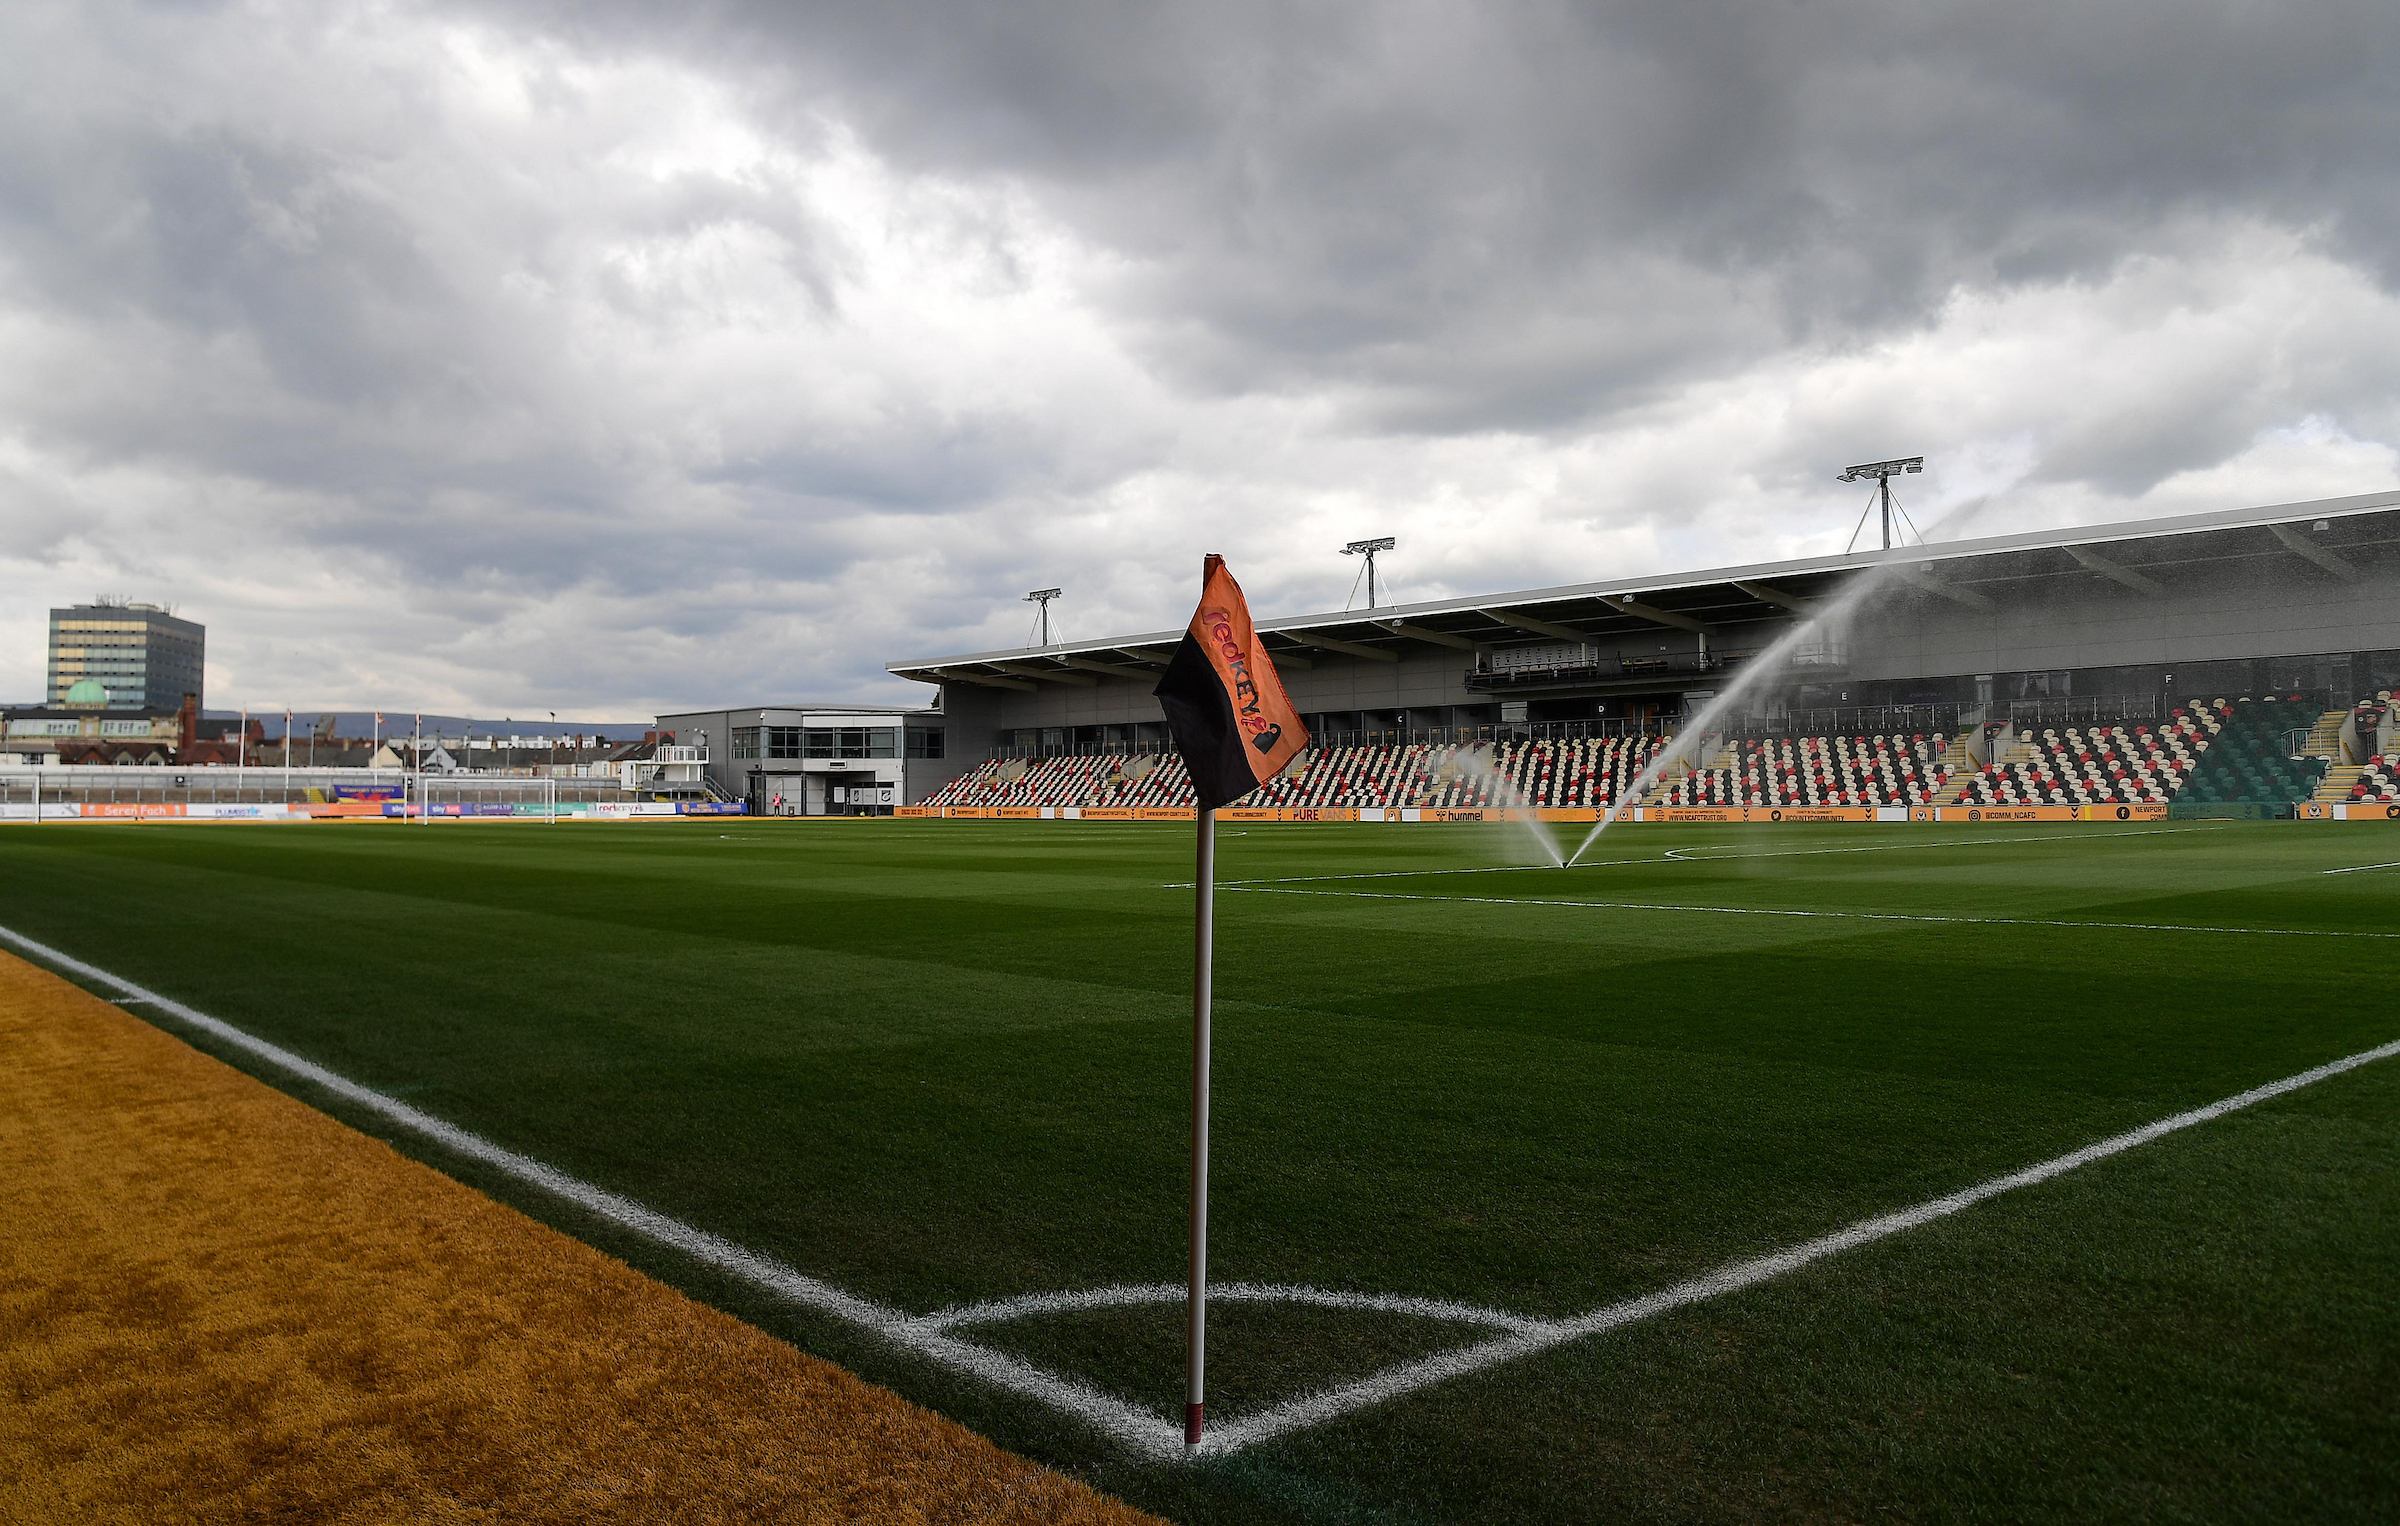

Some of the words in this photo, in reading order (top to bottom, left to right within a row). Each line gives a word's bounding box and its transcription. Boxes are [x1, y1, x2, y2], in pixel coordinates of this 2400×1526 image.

[2165, 674, 2172, 684] F
[1841, 692, 1848, 700] E
[1598, 705, 1605, 713] D
[1397, 715, 1403, 723] C
[104, 805, 137, 815] Seren
[140, 805, 166, 815] Fach
[432, 804, 445, 814] sky
[445, 804, 460, 813] bet
[1293, 809, 1319, 820] PURE
[1320, 809, 1347, 821] VANS
[1448, 810, 1483, 821] hummel
[1985, 811, 2036, 821] @COMM_NCAFC
